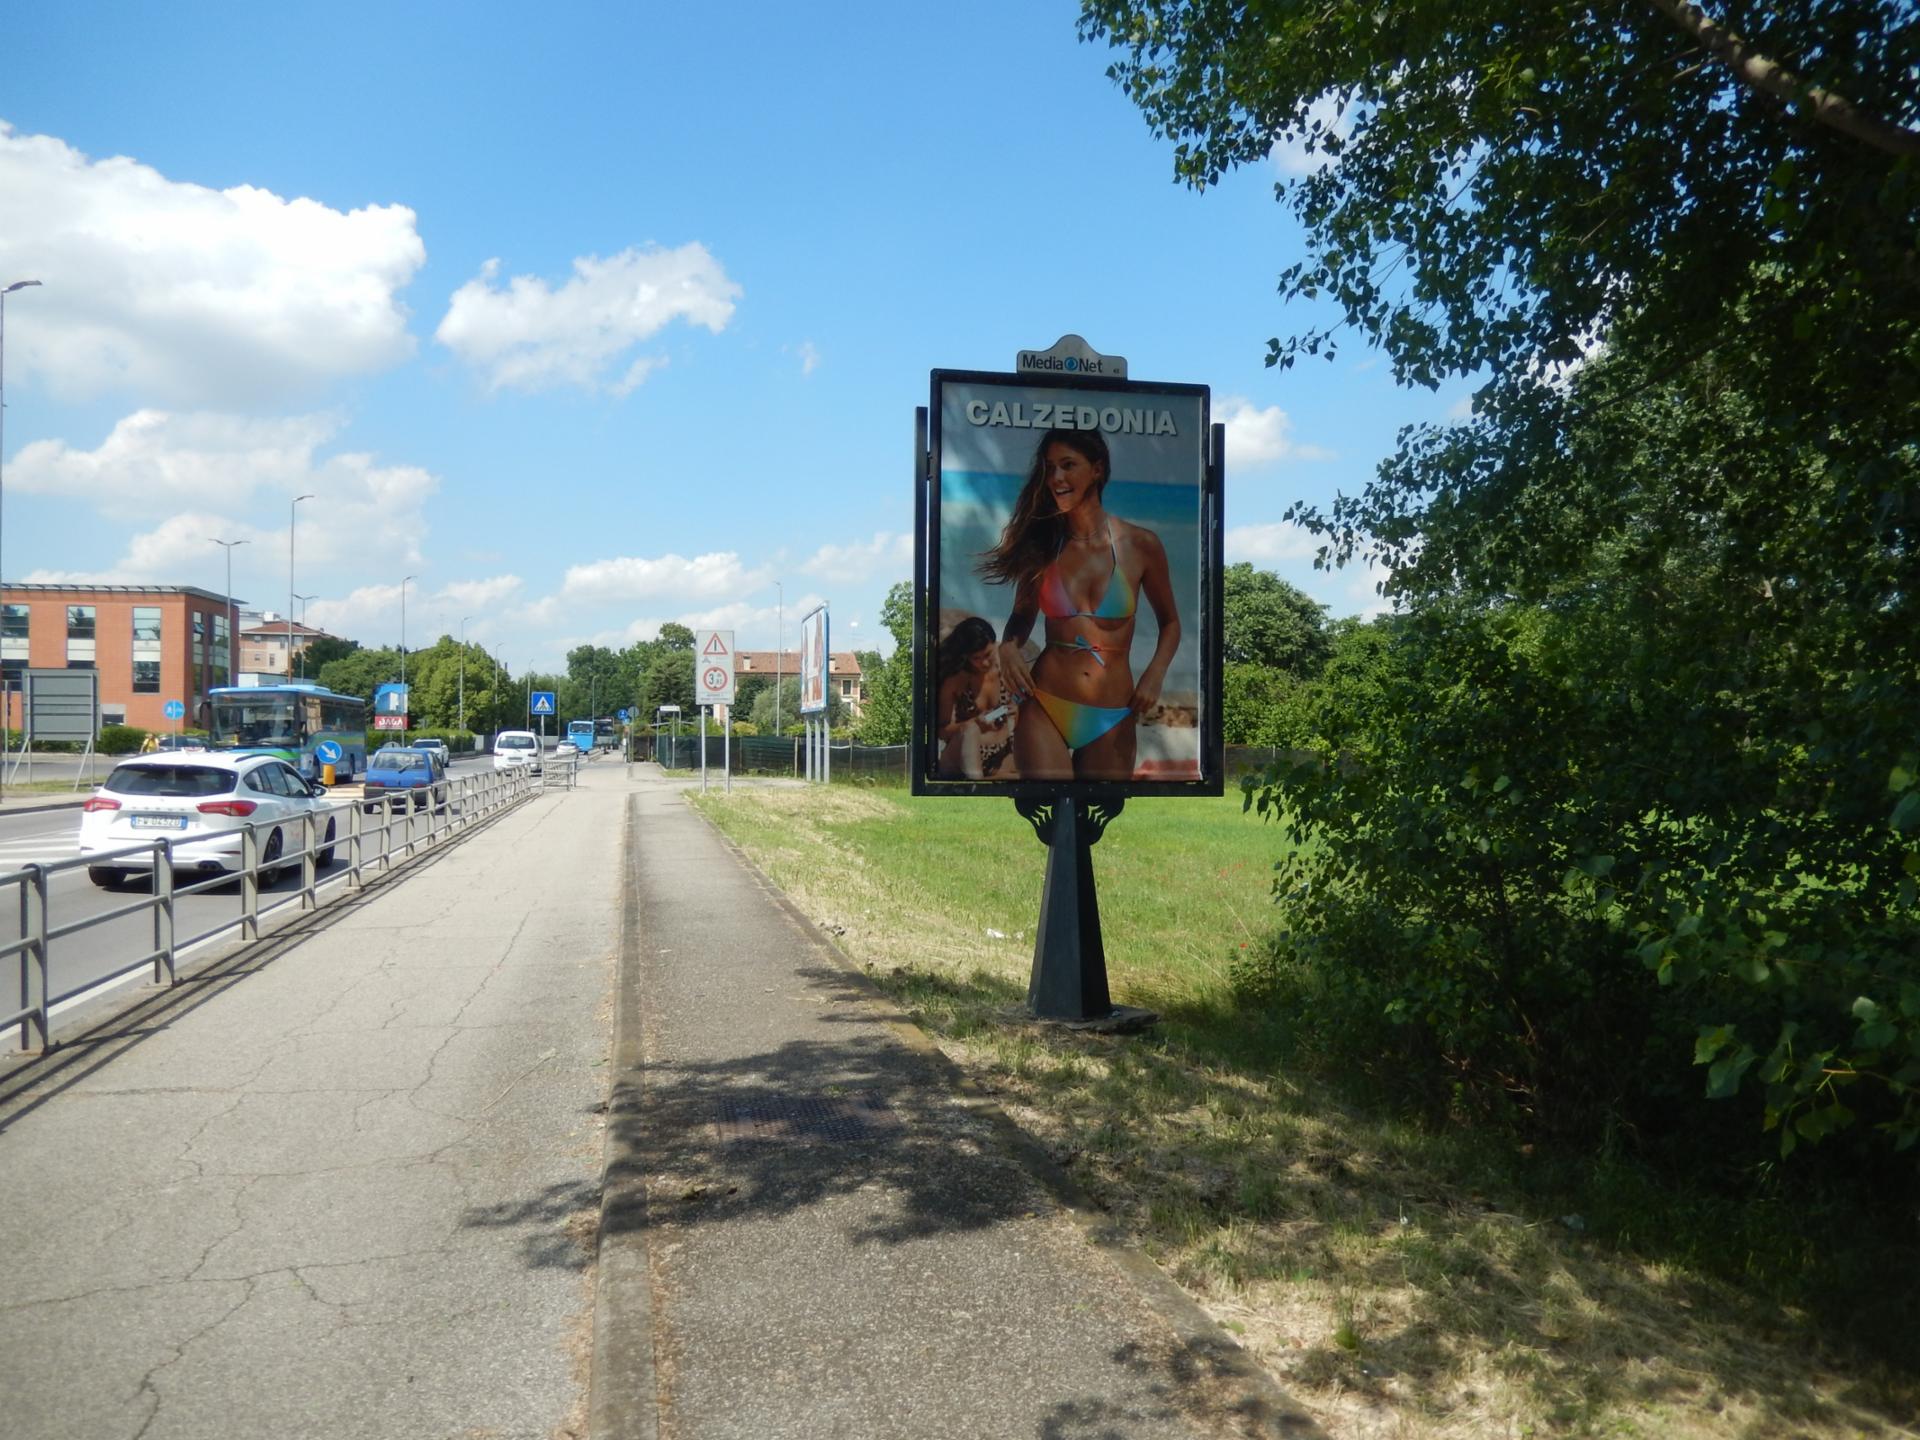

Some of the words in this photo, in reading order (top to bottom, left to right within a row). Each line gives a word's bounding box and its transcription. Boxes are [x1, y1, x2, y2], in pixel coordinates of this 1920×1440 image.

[1022, 353, 1064, 371] Media
[1079, 358, 1103, 373] Net
[966, 399, 1178, 436] CALZEDONIA
